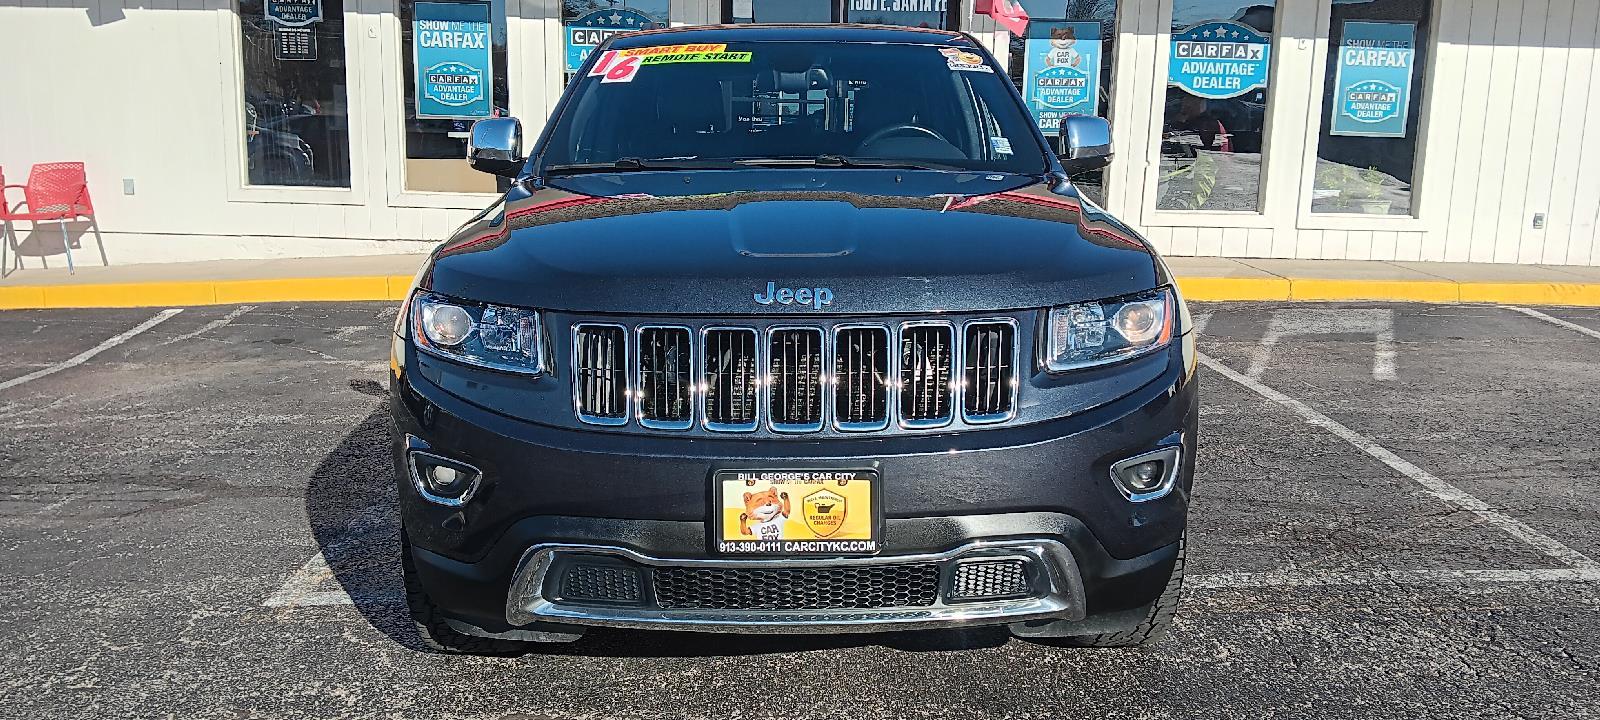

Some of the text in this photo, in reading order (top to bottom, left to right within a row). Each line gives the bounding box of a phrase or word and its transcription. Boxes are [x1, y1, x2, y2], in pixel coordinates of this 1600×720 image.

[275, 5, 313, 13] ADVANTAGE
[281, 12, 307, 20] DEALER
[420, 20, 449, 31] SHOW
[420, 31, 485, 49] CARFAX
[1346, 39, 1375, 49] SHOW
[625, 44, 722, 56] SMART BUY
[1177, 43, 1262, 59] CARFAX
[642, 52, 749, 63] REMOTE START
[1345, 50, 1408, 67] CARFAX
[1181, 62, 1255, 75] ADVANTAGE
[430, 75, 478, 84] CARFAX
[1038, 78, 1085, 87] CARFAX
[1193, 77, 1241, 89] DEALER
[433, 85, 475, 93] ADVANTAGE
[440, 93, 468, 101] DEALER
[1349, 93, 1395, 102] CARFAX
[1351, 102, 1392, 111] ADVANTAGE
[753, 281, 833, 309] Jeep
[761, 525, 779, 535] CAR
[719, 541, 876, 553] 913-390-0111 CARCITYKC.COM
